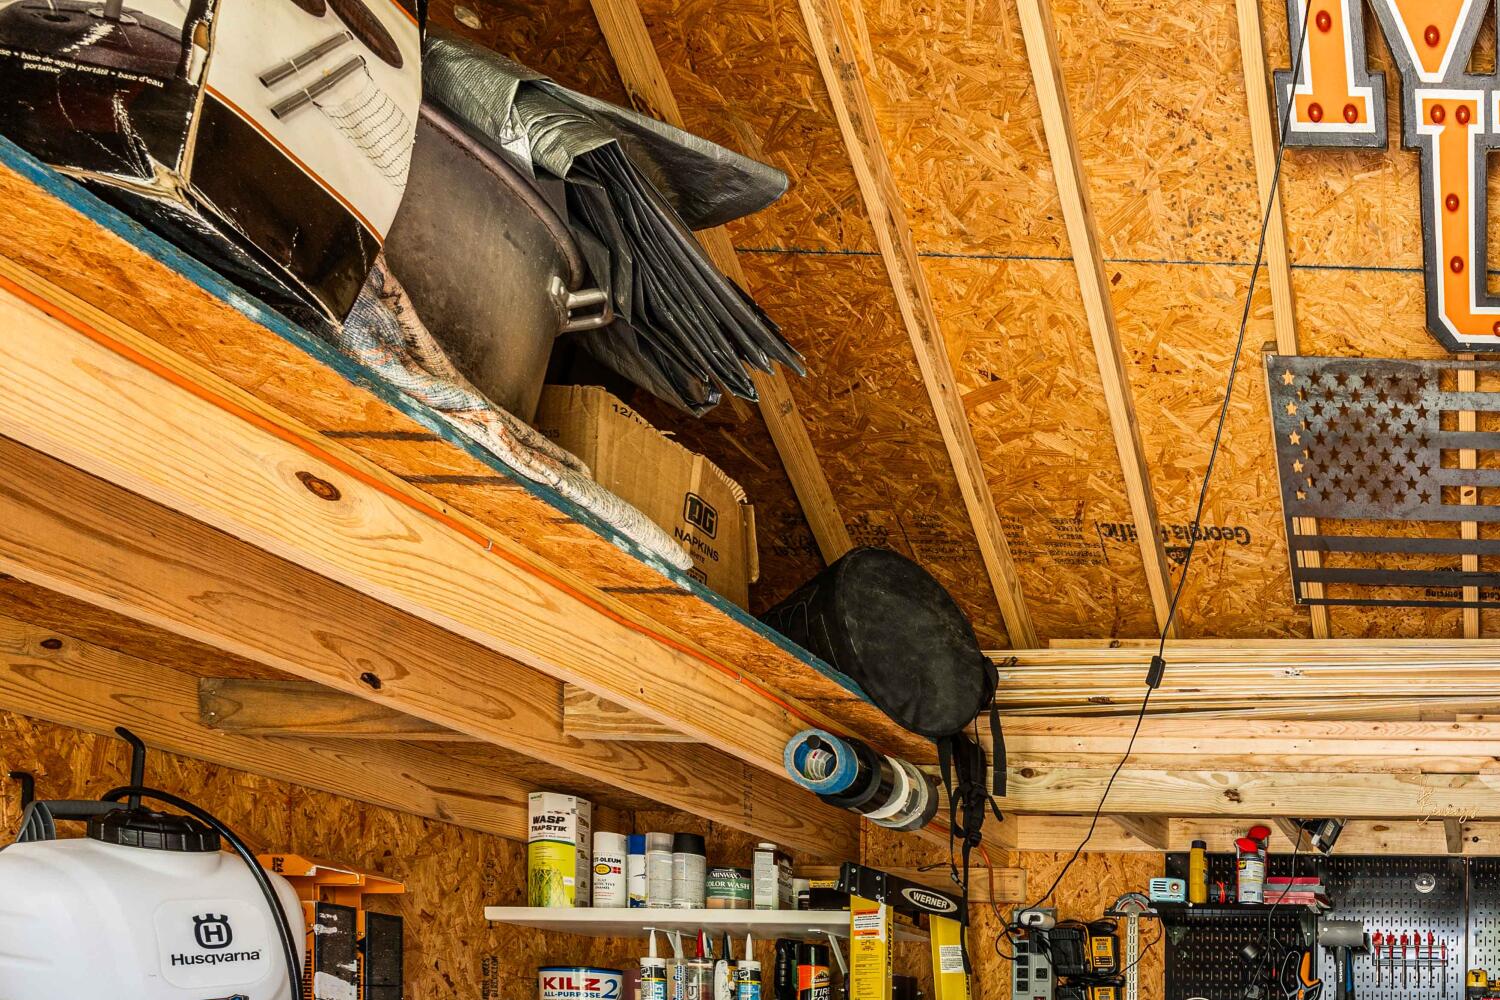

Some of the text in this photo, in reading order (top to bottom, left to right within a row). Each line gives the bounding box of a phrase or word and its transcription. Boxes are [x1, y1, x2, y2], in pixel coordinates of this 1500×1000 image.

[21, 52, 41, 62] base
[42, 55, 54, 64] de
[55, 58, 76, 69] agua
[78, 63, 109, 76] portátil
[117, 71, 138, 81] base
[139, 75, 164, 88] d'eau
[23, 62, 61, 74] portative
[674, 527, 719, 562] NAPKINS
[532, 815, 565, 825] WASP
[727, 882, 750, 890] WASH
[913, 891, 948, 909] WERNER
[171, 950, 260, 966] Husqvarna
[543, 977, 618, 999] KILZ 2
[655, 983, 665, 1000] FLEX
